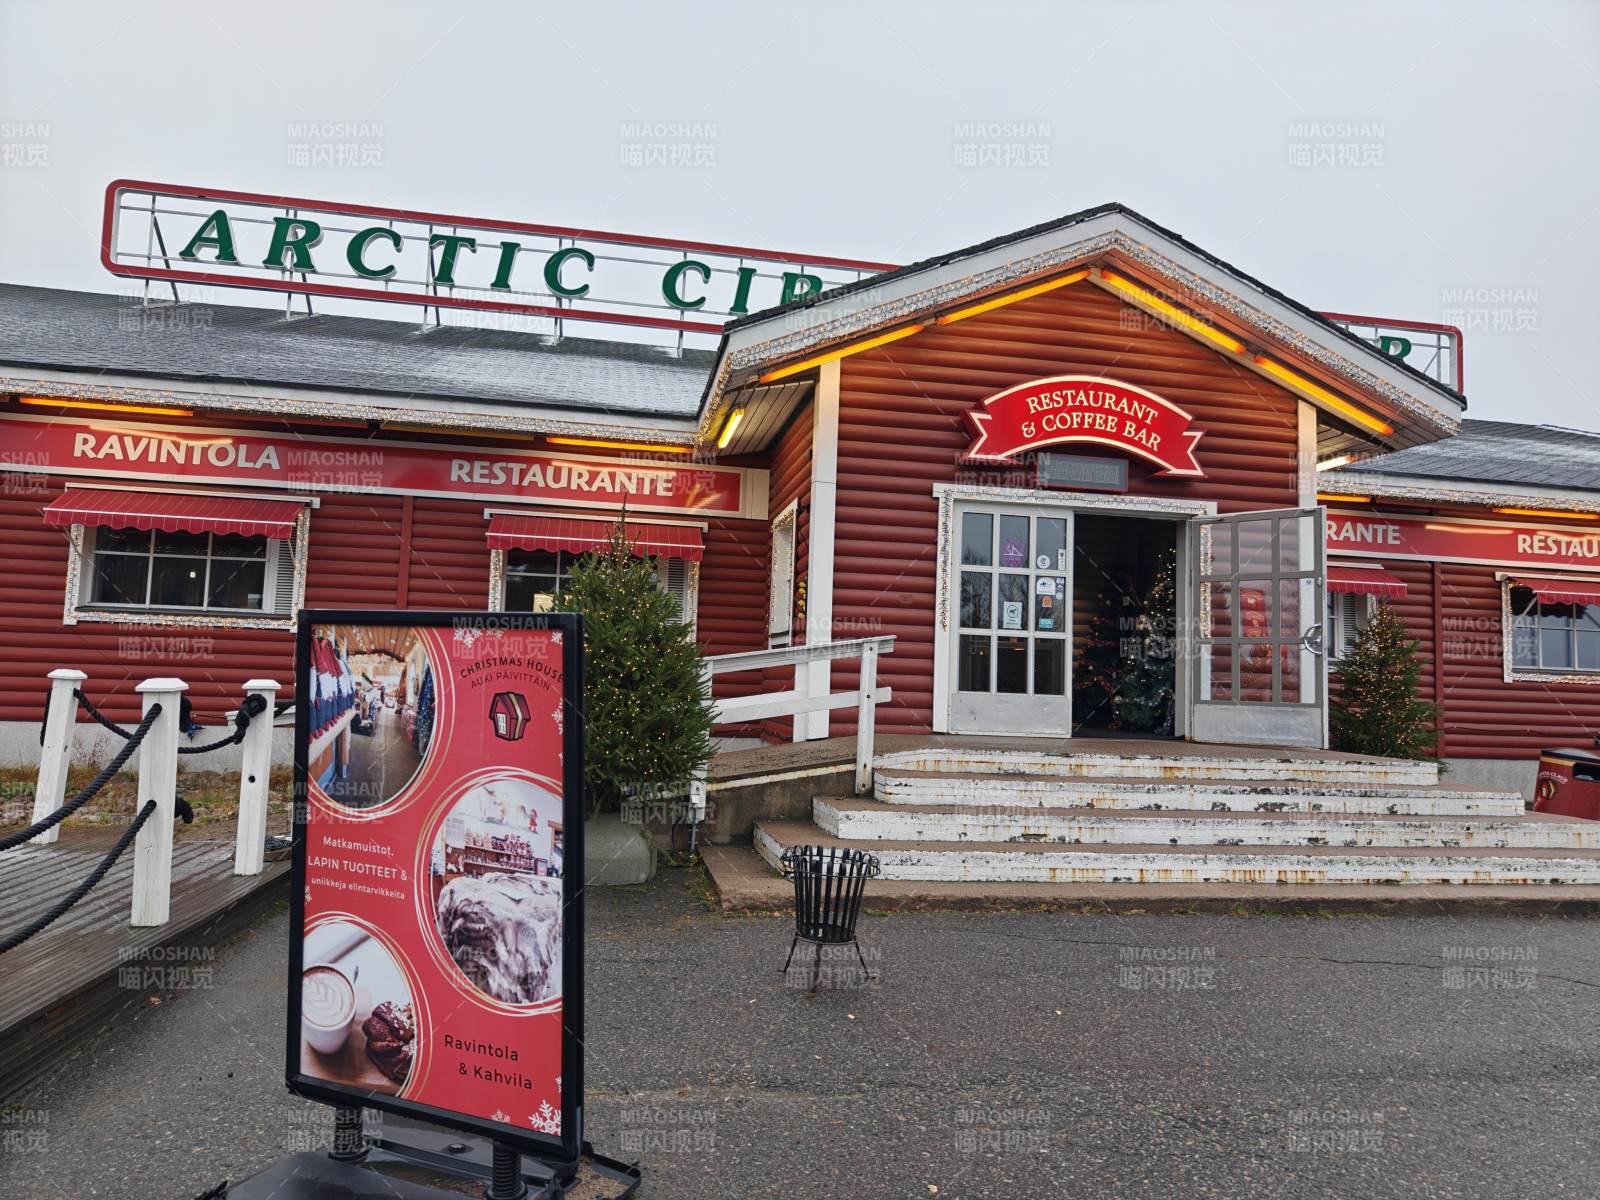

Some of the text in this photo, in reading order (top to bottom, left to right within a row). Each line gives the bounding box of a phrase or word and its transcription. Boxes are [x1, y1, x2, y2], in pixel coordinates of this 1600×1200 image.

[179, 209, 595, 299] ARCTIC
[1026, 389, 1158, 425] RESTAURANT
[1021, 412, 1161, 451] & COFFEE BAR
[73, 432, 674, 497] RAVINTOLA RESTAURANTE
[1326, 520, 1600, 557] RANTE RESTAU
[461, 656, 565, 683] CHRISTMAS HOUSE
[471, 674, 493, 689] AUKI
[308, 856, 408, 881] LAPIN TUOTTEET &
[311, 877, 347, 890] uniikkeja
[444, 1034, 519, 1061] Ravintola
[458, 1062, 533, 1089] & Kahvila
